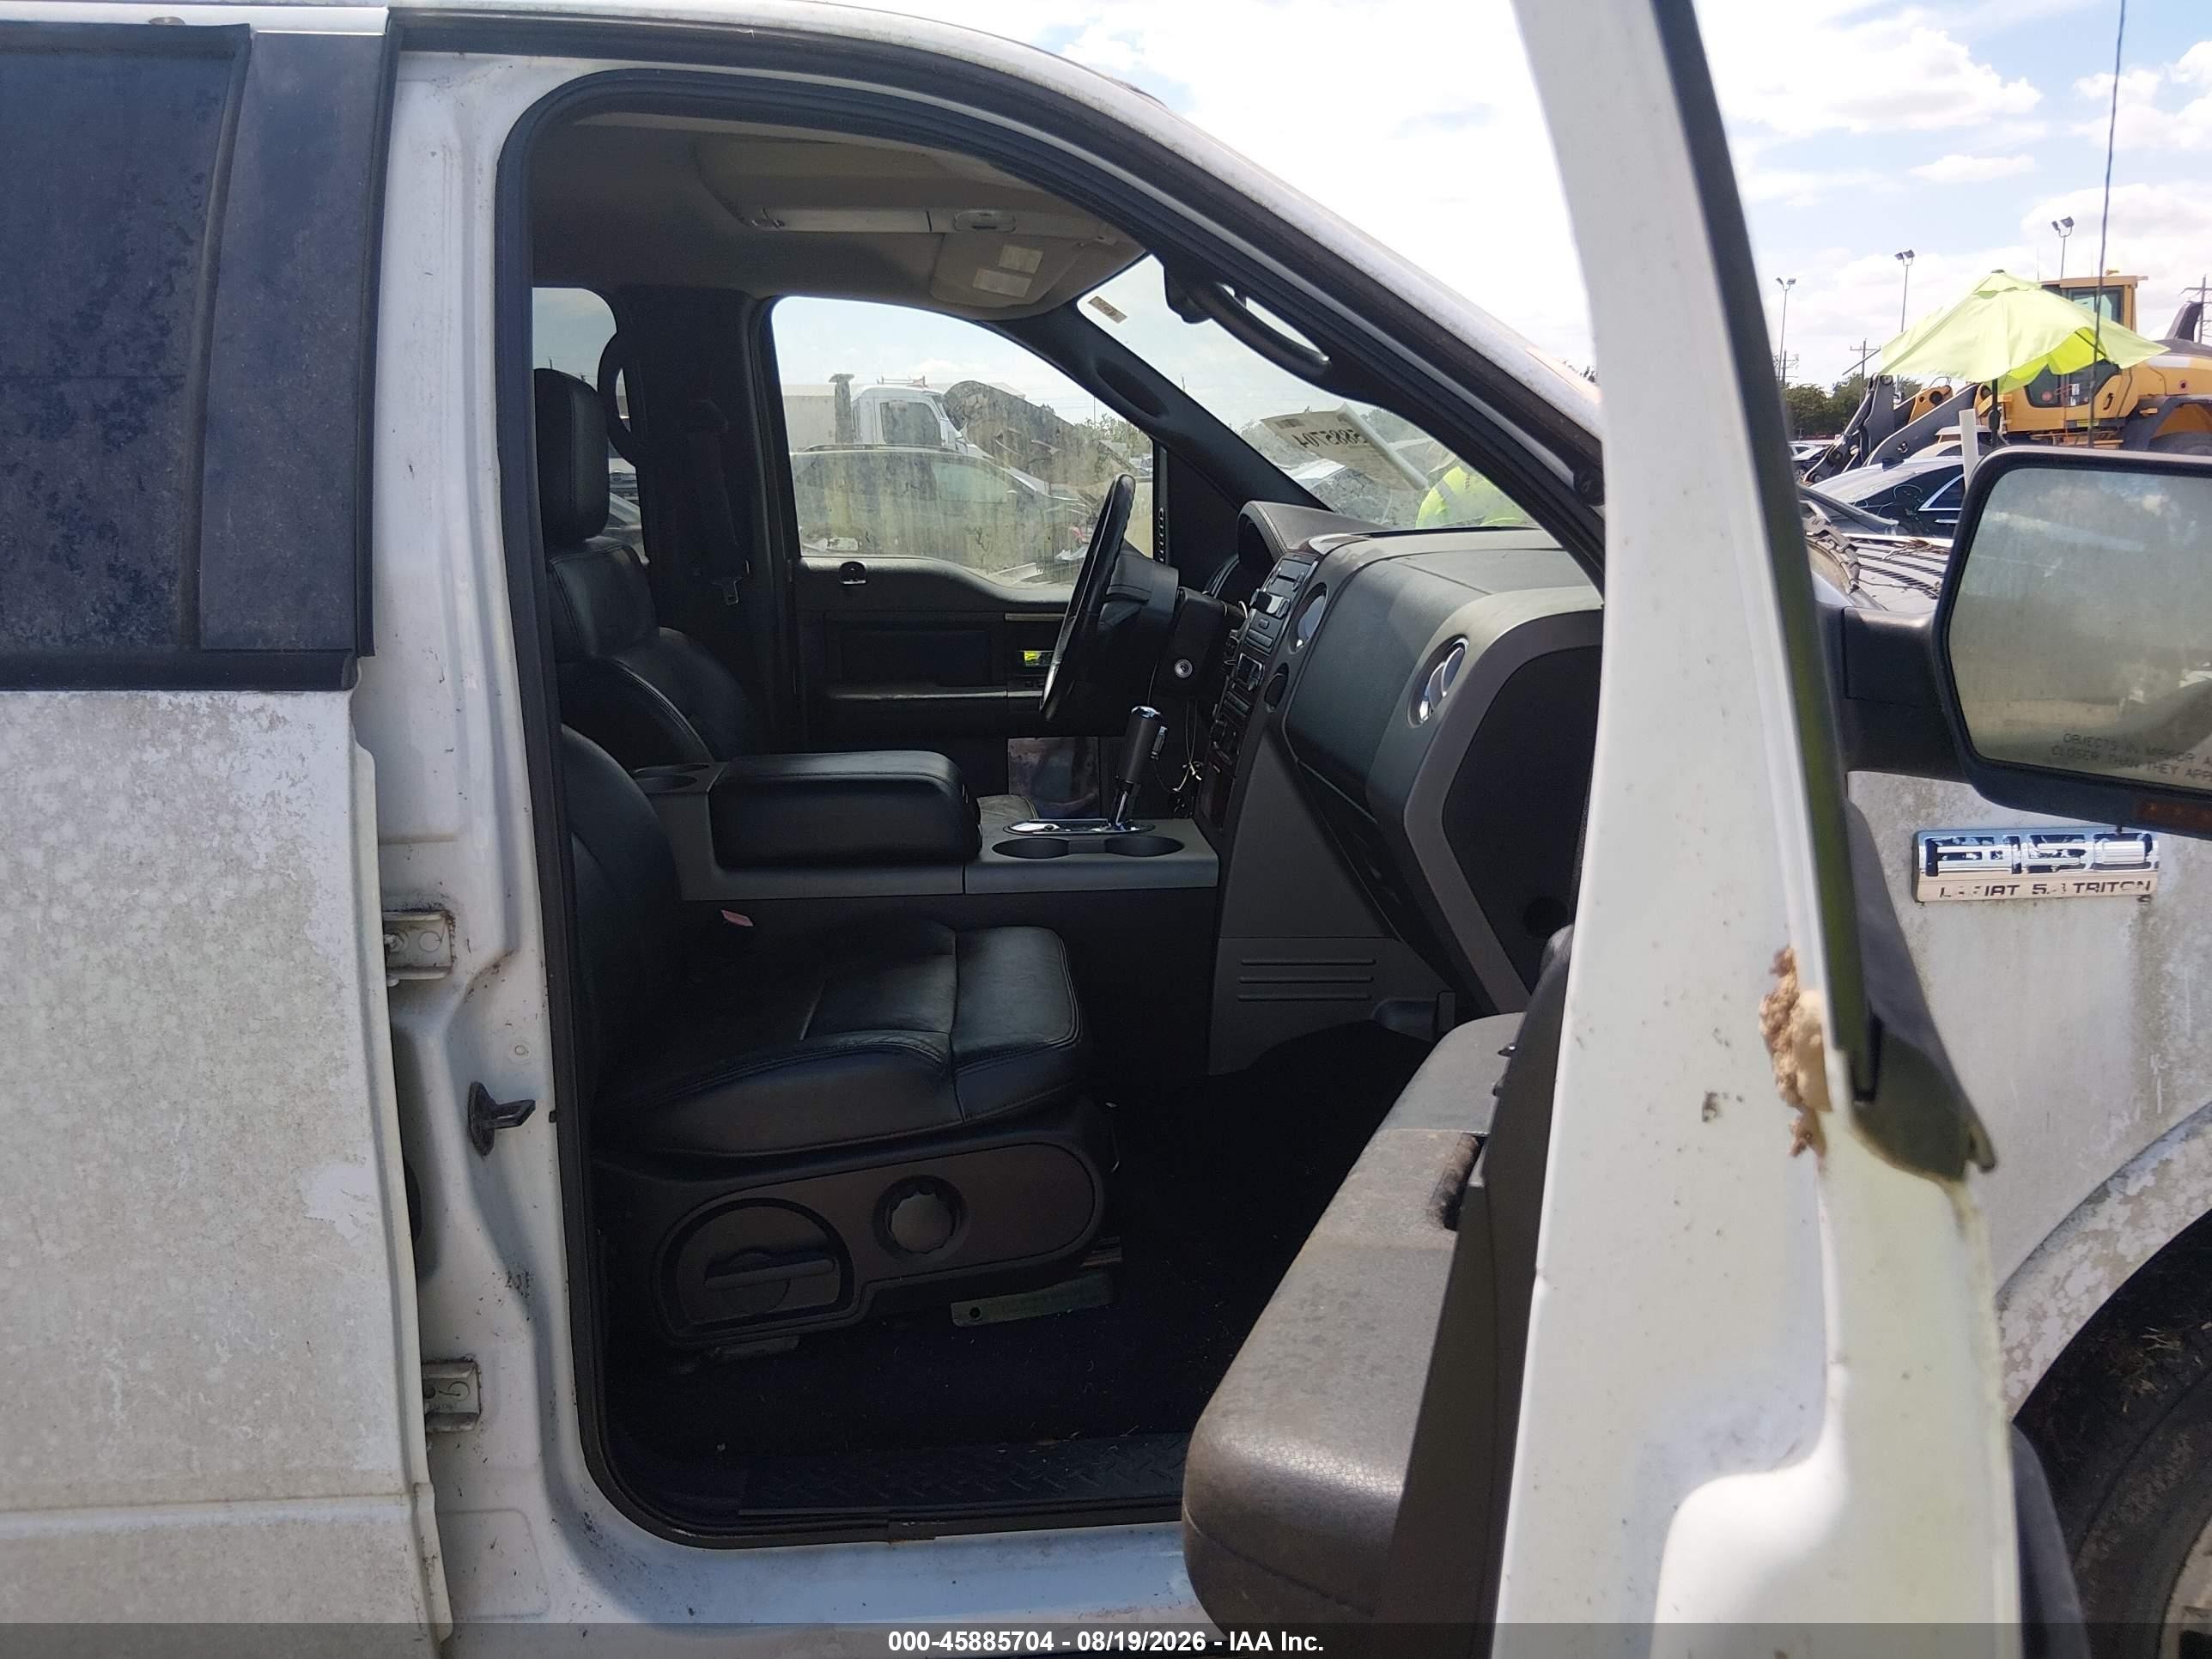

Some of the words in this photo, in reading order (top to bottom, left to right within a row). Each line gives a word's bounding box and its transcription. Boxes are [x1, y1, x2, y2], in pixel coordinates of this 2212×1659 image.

[2063, 732, 2118, 751] OBJECTS
[2051, 744, 2100, 762] CLOSER
[2147, 760, 2180, 775] THEY
